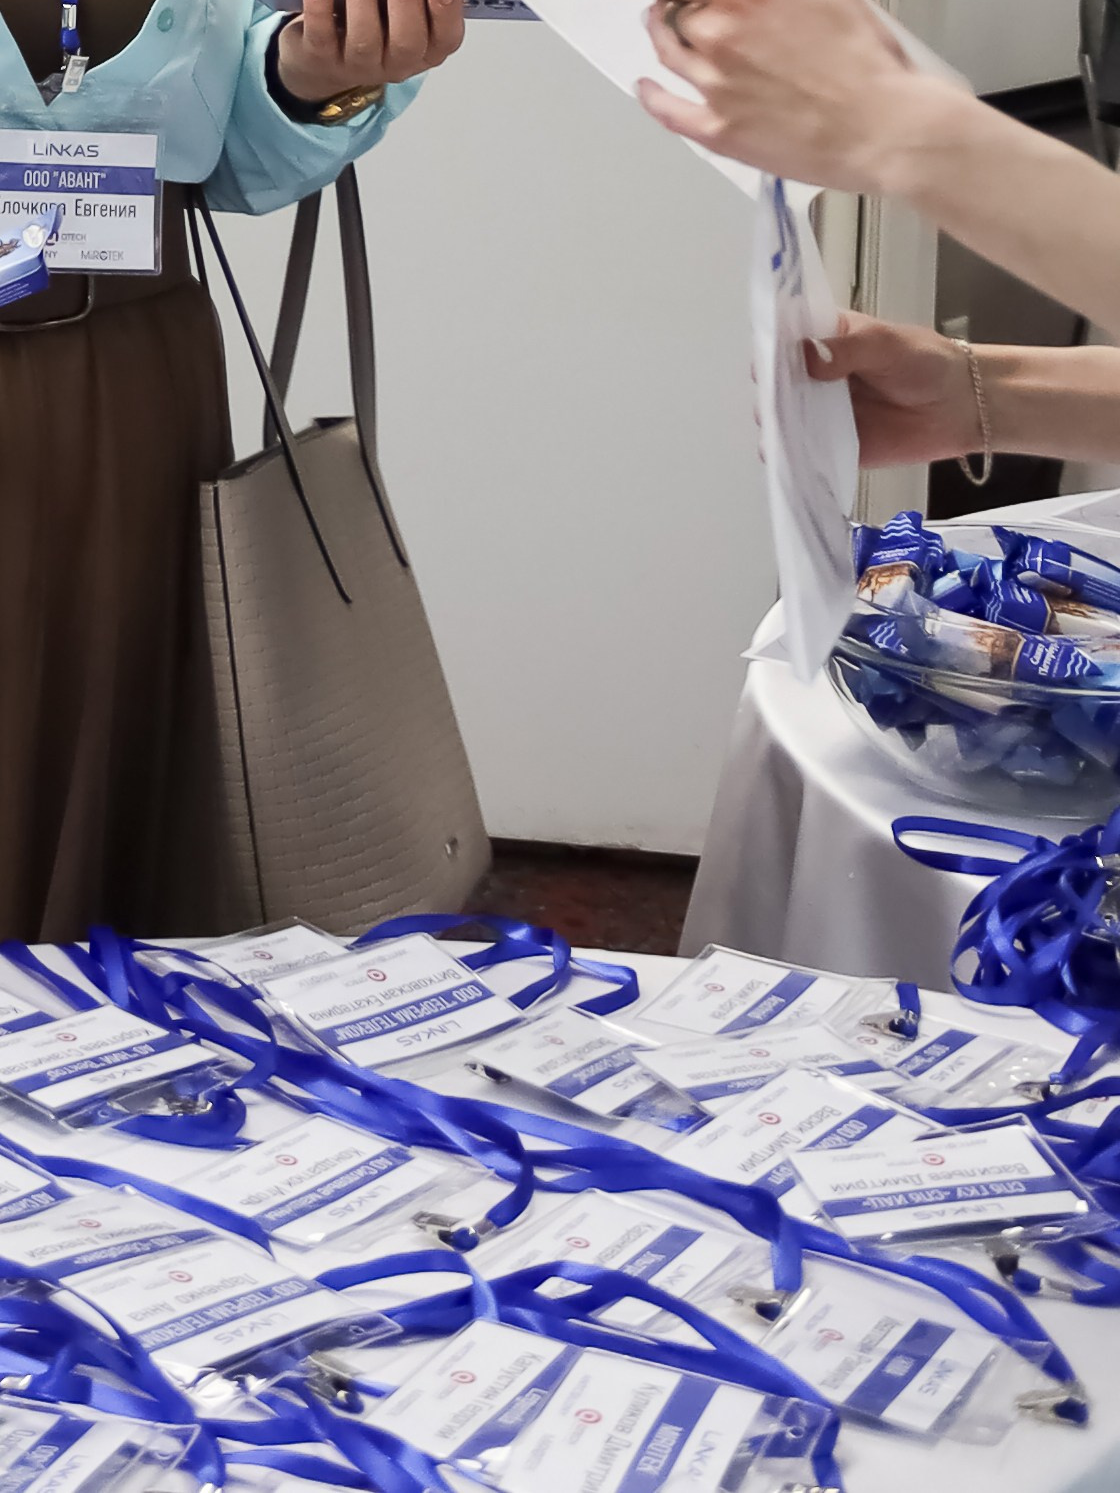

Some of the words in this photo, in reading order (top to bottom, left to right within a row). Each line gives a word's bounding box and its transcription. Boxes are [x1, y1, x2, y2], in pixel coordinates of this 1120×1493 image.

[24, 170, 50, 187] ООО
[53, 170, 106, 189] "АВАНТ"
[75, 199, 136, 218] Евгения
[375, 967, 464, 1002] Витковская
[448, 983, 485, 1001] ООО
[305, 992, 386, 1025] Екатерина
[388, 993, 460, 1022] "ТЕОРЕМА
[789, 1104, 844, 1136] Васюк
[834, 1118, 870, 1138] ООО
[366, 1156, 396, 1170] АО
[731, 1130, 805, 1174] Дмитрий
[276, 1145, 367, 1189] Кондратюк
[314, 1164, 381, 1197] Силовые
[926, 1161, 1031, 1185] Васильев
[236, 1183, 291, 1210] Игорь
[827, 1172, 927, 1195] Дмитрий
[952, 1185, 990, 1198] ГКУ
[262, 1191, 323, 1221] машины
[20, 1235, 103, 1260] Алексей
[269, 1279, 309, 1296] ООО
[125, 1300, 178, 1325] Анна
[201, 1288, 282, 1321] "ТЕОРЕМА
[473, 1349, 547, 1403] Капустин
[429, 1395, 496, 1444] Георгий
[607, 1380, 666, 1435] Куликов
[572, 1433, 635, 1493] Дмитри
